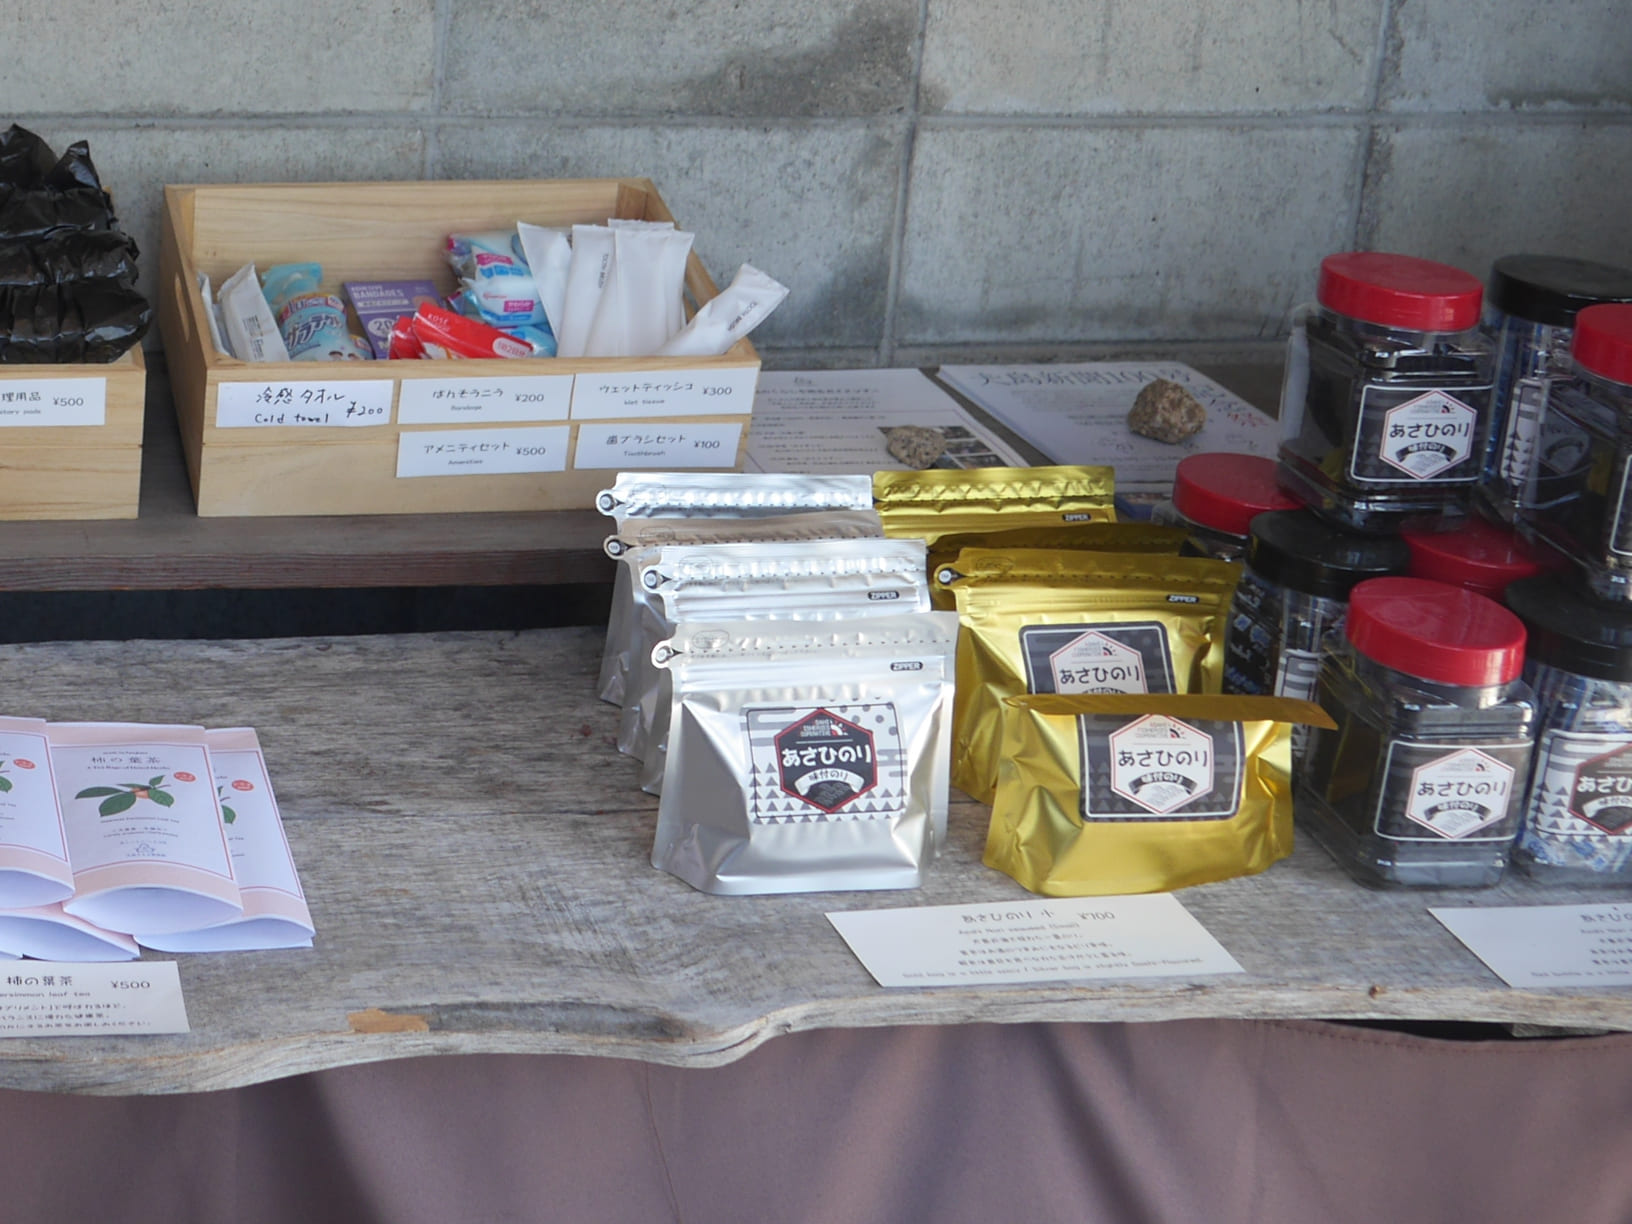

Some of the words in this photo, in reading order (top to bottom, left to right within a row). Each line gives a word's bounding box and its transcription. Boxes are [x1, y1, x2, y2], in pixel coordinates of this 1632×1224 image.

[515, 393, 545, 403] ¥200
[702, 386, 733, 396] ¥300
[53, 397, 85, 407] ¥500
[1389, 422, 1471, 438] あさひのり
[516, 446, 546, 456] ¥500
[693, 440, 720, 449] ¥100
[1059, 665, 1140, 685] あさひのり
[781, 744, 873, 767] あさひのり
[1117, 749, 1208, 768] あさひのり
[1417, 780, 1507, 797] あさひのり
[7, 975, 73, 987] 柿の葉茶
[110, 980, 151, 989] ¥500
